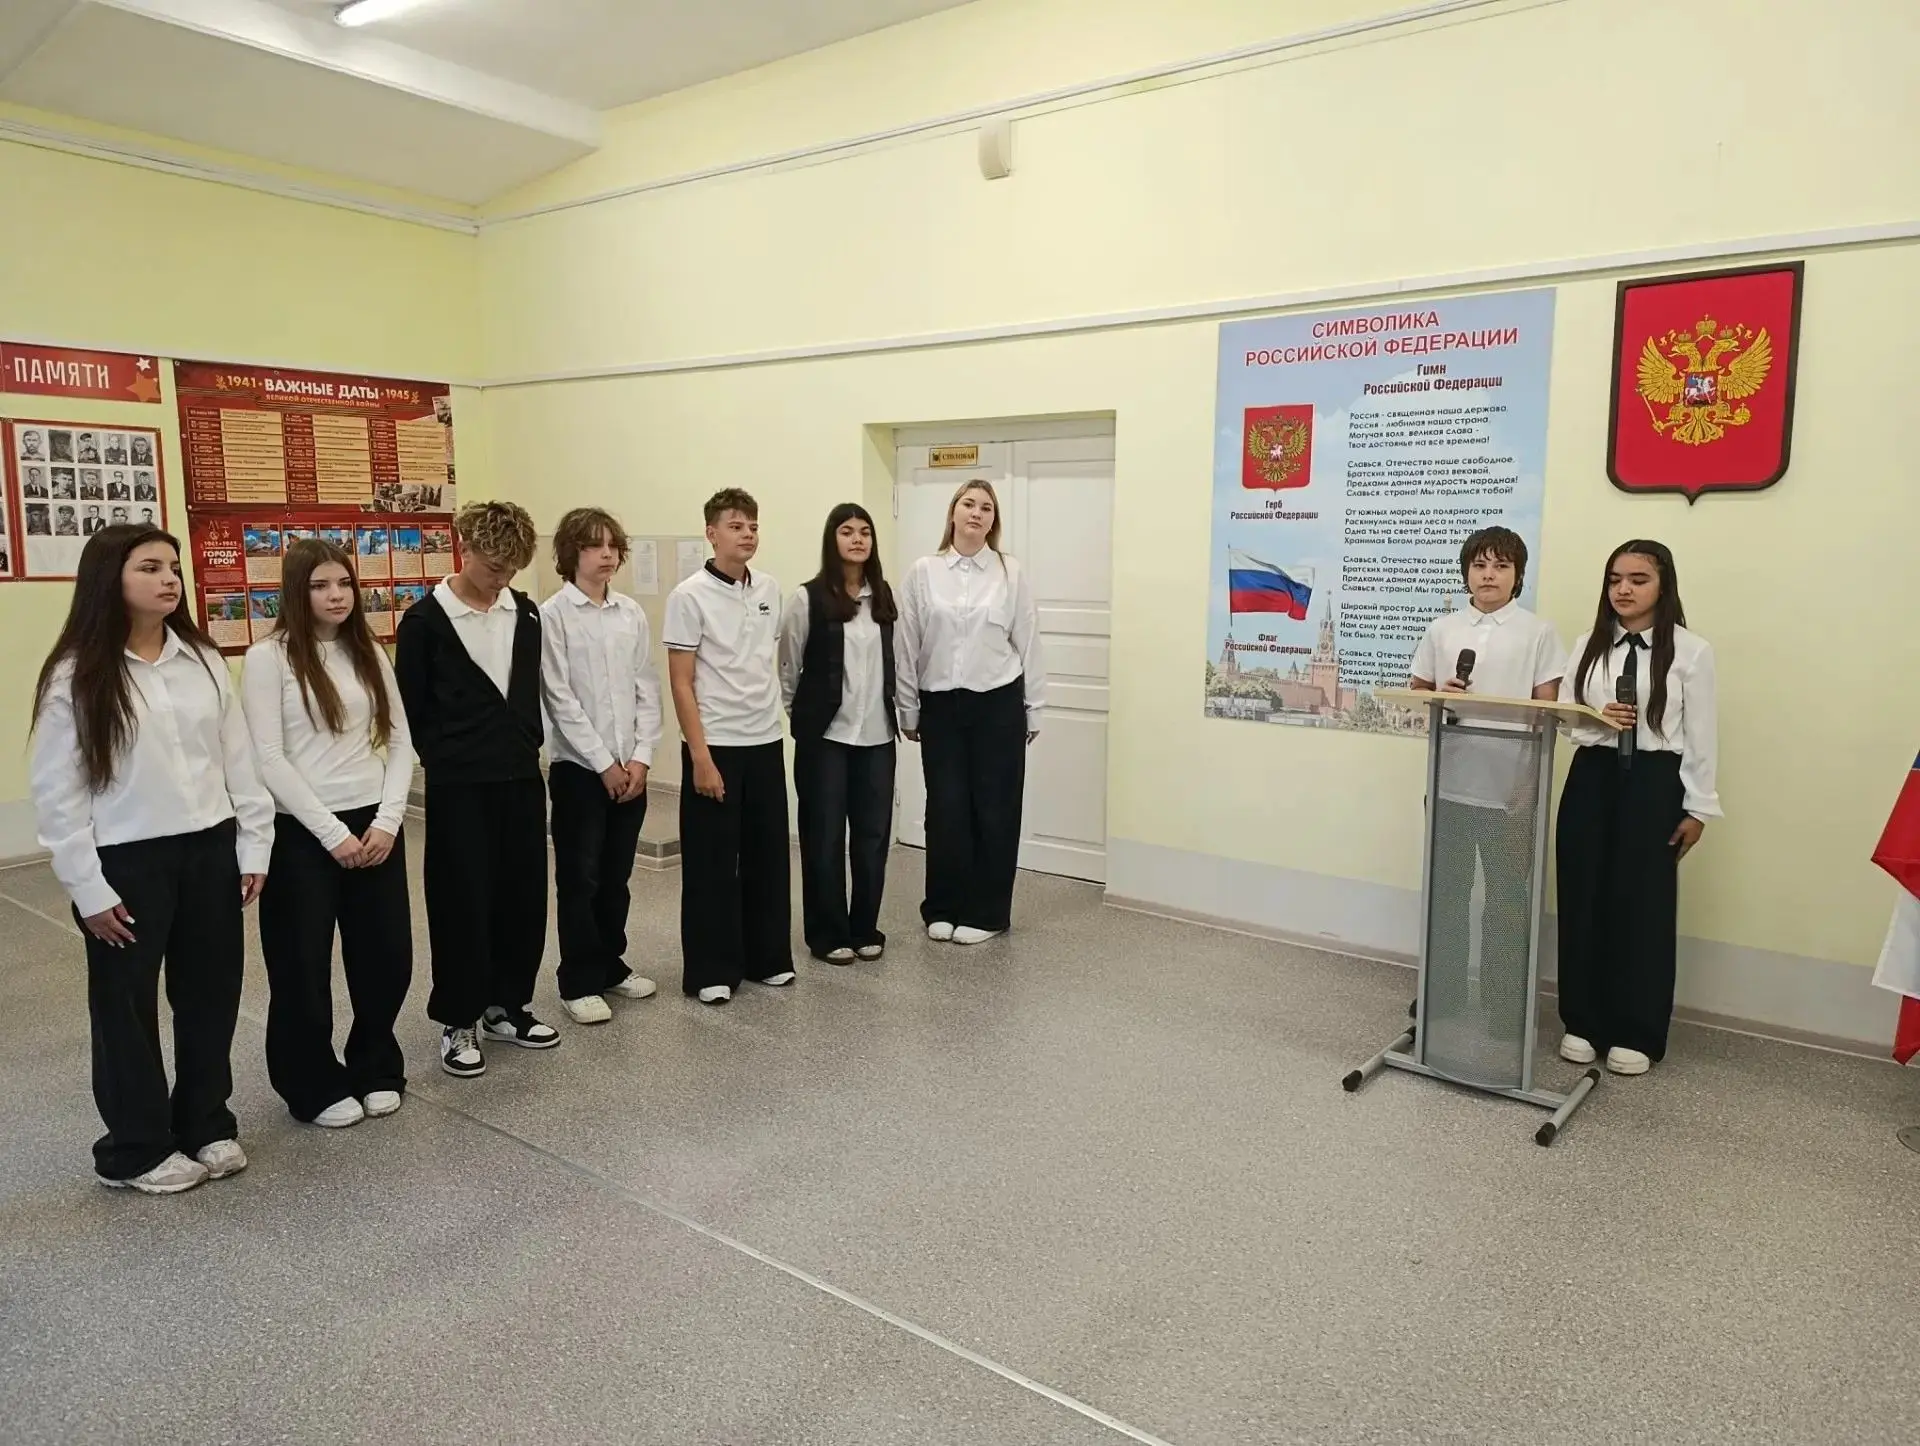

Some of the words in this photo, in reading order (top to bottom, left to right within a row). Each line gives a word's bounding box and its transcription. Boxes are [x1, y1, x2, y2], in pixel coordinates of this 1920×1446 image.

[1312, 310, 1440, 339] СИМВОЛИКА
[1245, 336, 1377, 367] РОССИЙСКОЙ
[1383, 327, 1518, 356] ФЕДЕРАЦИИ
[14, 357, 110, 389] ПАМЯТИ
[1416, 363, 1446, 376] Гимн
[227, 375, 256, 388] 1941
[264, 378, 333, 396] ВАЖНЫЕ
[338, 385, 379, 399] ДАТЫ
[386, 388, 410, 400] 1945
[1363, 378, 1431, 396] Российской
[1433, 375, 1503, 391] Федерации
[1350, 412, 1379, 420] Россия
[1386, 410, 1435, 418] священная
[1349, 422, 1379, 430] Россия
[1386, 420, 1425, 428] любимая
[1427, 418, 1452, 426] наша
[1349, 432, 1384, 440] Могучая
[1408, 429, 1444, 437] великая
[1368, 440, 1413, 448] достоянье
[1446, 436, 1490, 446] времена!
[1385, 459, 1433, 467] Отечество
[1347, 470, 1385, 478] Братских
[1388, 469, 1424, 477] народов
[1346, 480, 1389, 488] Предками
[1390, 479, 1422, 487] данная
[1424, 478, 1468, 486] мудрость
[1470, 475, 1518, 485] народная!
[1384, 488, 1418, 497] страна!
[1436, 488, 1480, 496] гордимся
[1483, 486, 1513, 494] тобой!
[1265, 499, 1283, 510] Герб
[1230, 511, 1274, 520] Российской
[1275, 511, 1318, 520] Федерации
[1345, 508, 1356, 516] От
[1389, 507, 1418, 516] морей
[1419, 508, 1431, 516] до
[1433, 508, 1479, 516] полярного
[1481, 508, 1503, 516] края
[1345, 518, 1397, 526] Раскинулись
[1344, 527, 1367, 535] Одна
[1423, 527, 1447, 535] Одна
[1344, 537, 1385, 545] Хранимая
[1415, 538, 1447, 546] родная
[203, 550, 242, 558] ГОРОДА-
[1381, 556, 1427, 564] Отечество
[1342, 565, 1380, 573] Братских
[1342, 574, 1384, 582] Предками
[1418, 577, 1461, 585] мудрость
[1341, 602, 1377, 610] Широкий
[1380, 605, 1415, 613] простор
[1258, 633, 1278, 642] Флаг
[1225, 641, 1267, 652] Российской
[1269, 644, 1312, 655] Федерации
